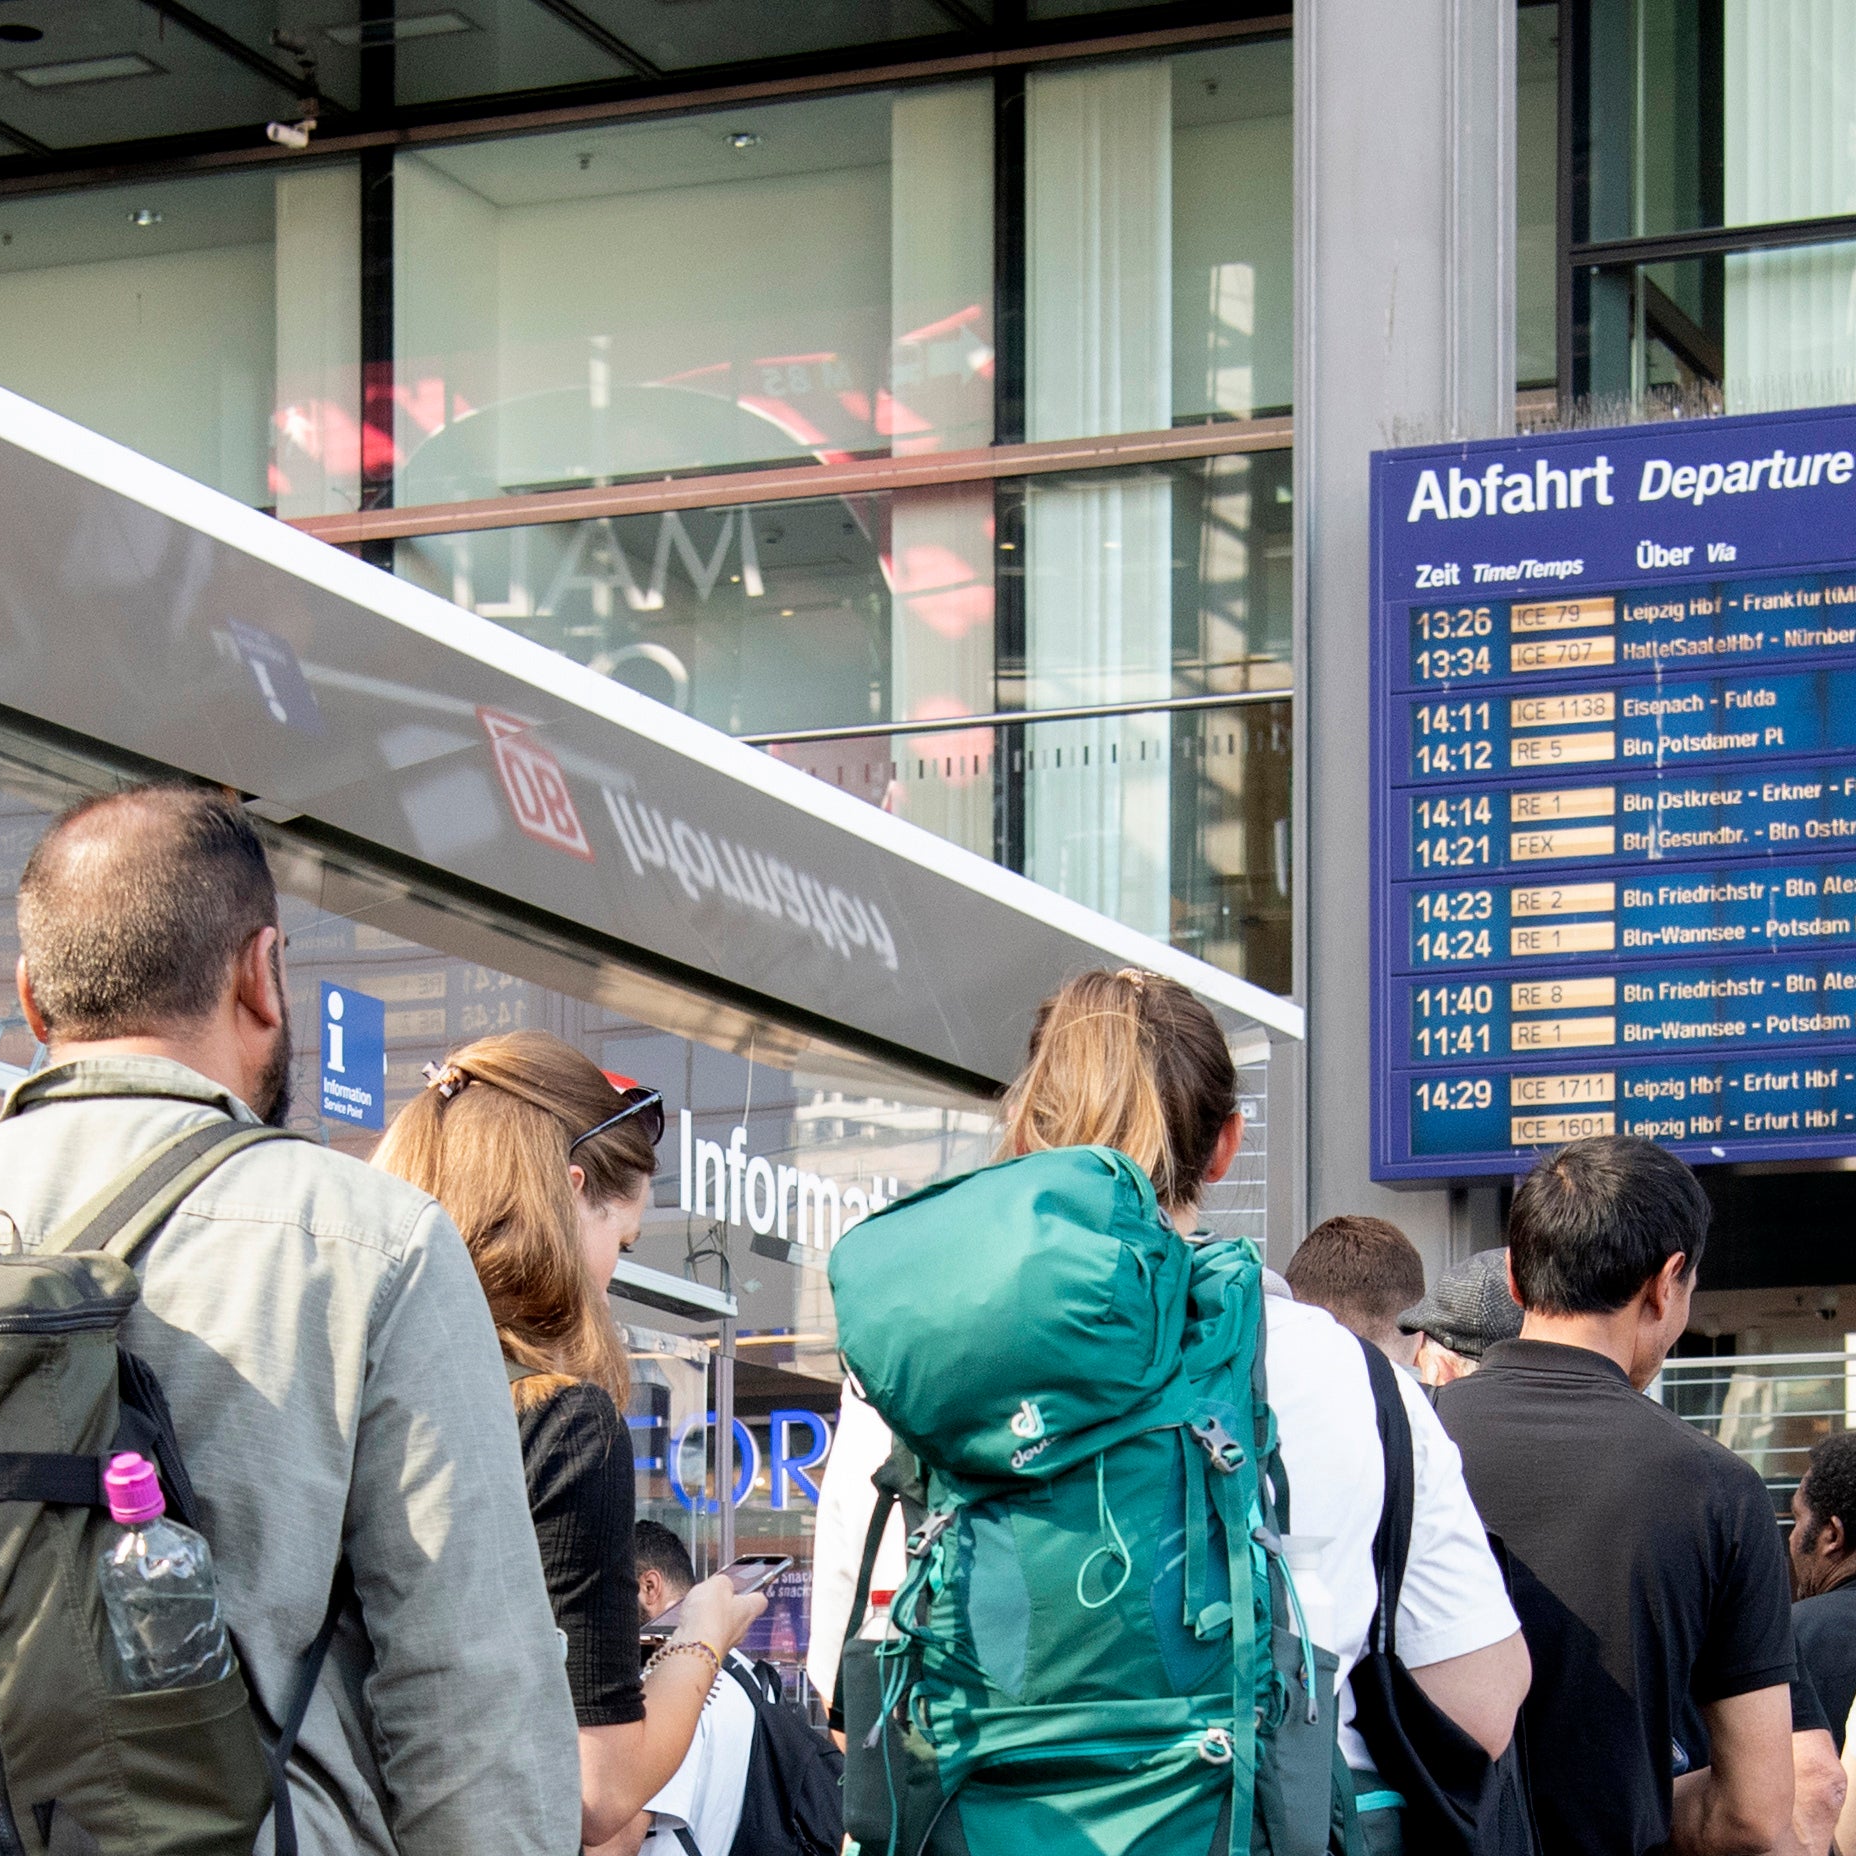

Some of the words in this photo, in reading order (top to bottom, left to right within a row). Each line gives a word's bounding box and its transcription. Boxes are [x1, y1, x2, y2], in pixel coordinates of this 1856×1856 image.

[1407, 456, 1614, 522] Abfahrt
[1638, 450, 1855, 506] Departure
[1416, 563, 1460, 588] Zeit
[1473, 559, 1584, 584] Time/Temps
[1637, 540, 1694, 568] Über
[1707, 543, 1737, 563] Via
[1517, 606, 1545, 625] ICE
[1556, 604, 1580, 623] 79
[1623, 602, 1684, 624] Leipzig
[1690, 597, 1722, 616] Hbf
[1417, 608, 1492, 640] 13:26
[1416, 647, 1492, 679] 13:34
[1517, 645, 1545, 666] ICE
[1557, 642, 1592, 662] 707
[1518, 702, 1545, 722] ICE
[1558, 698, 1606, 718] 1138
[1623, 694, 1703, 717] Eisenach
[1725, 689, 1776, 709] Fulda
[1417, 702, 1490, 735] 14:11
[1518, 742, 1541, 761] RE
[1551, 740, 1562, 759] 5
[1623, 740, 1653, 757] Bln
[1659, 731, 1759, 753] Potsdamer
[1765, 727, 1784, 746] Pl
[1417, 741, 1492, 773] 14:12
[1623, 795, 1653, 812] Bln
[1763, 782, 1822, 801] Erkner
[1417, 797, 1492, 829] 14:14
[1518, 797, 1541, 815] RE
[1553, 795, 1561, 813] 1
[1659, 826, 1748, 848] Gesundbr.
[1769, 822, 1799, 841] Bln
[1417, 836, 1490, 868] 14:21
[1518, 836, 1553, 855] FEX
[1518, 893, 1541, 911] RE
[1551, 891, 1562, 909] 2
[1623, 890, 1653, 907] Bln
[1659, 882, 1765, 906] Friedrichstr
[1417, 891, 1492, 923] 14:23
[1623, 925, 1745, 946] Bln-Wannsee
[1766, 915, 1849, 938] Potsdam
[1417, 929, 1492, 961] 14:24
[1518, 931, 1541, 949] RE
[1553, 930, 1561, 948] 1
[1417, 985, 1492, 1017] 11:40
[1417, 1024, 1490, 1056] 11:41
[324, 1077, 372, 1106] Information
[1518, 1082, 1545, 1100] ICE
[1558, 1078, 1605, 1097] 1711
[1624, 1079, 1684, 1101] Leipzig
[1691, 1076, 1722, 1094] Hbf
[1744, 1072, 1798, 1091] Erfurt
[1805, 1069, 1838, 1088] Hbf
[1416, 1080, 1492, 1111] 14:29
[324, 1097, 346, 1114] Service
[347, 1104, 363, 1119] Point
[1518, 1121, 1545, 1139] ICE
[1558, 1118, 1606, 1137] 1601
